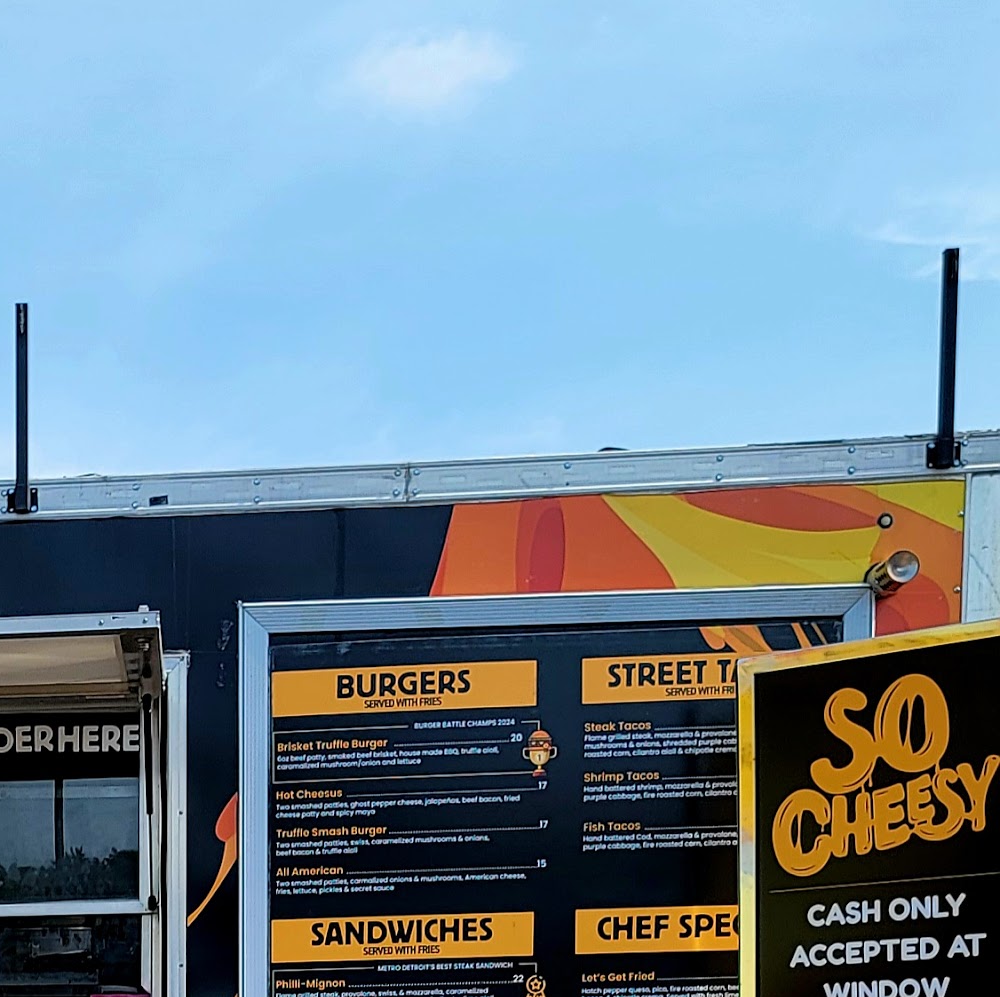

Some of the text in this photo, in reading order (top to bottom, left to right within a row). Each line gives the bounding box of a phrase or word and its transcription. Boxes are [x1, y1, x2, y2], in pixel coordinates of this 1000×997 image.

[608, 660, 707, 687] STREET
[337, 669, 470, 699] BURGERS
[665, 686, 697, 697] SERVED
[698, 685, 720, 695] WITH
[364, 695, 442, 709] SERVED WITH FRIES
[584, 720, 651, 732] Steak Tacos
[810, 674, 950, 794] SO
[57, 723, 140, 754] HERE
[277, 732, 523, 752] Brisket Truffle Burger 20
[584, 770, 659, 783] Shrimp Tacos
[276, 780, 547, 800] Hot Cheesus 17
[772, 754, 1000, 877] CHEESY
[276, 819, 548, 838] Truffle Smash Burger 17
[583, 821, 641, 832] Fish Tacos
[276, 858, 547, 876] All American 15
[807, 893, 966, 927] CASH ONLY
[311, 917, 493, 946] SANDWICHES
[597, 915, 669, 940] CHEF
[363, 944, 440, 955] SERVED WITH FRIES
[789, 933, 987, 968] ACCEPTED AT
[276, 973, 524, 990] Philli-Mignon 22
[582, 971, 655, 982] Let's Get Fried
